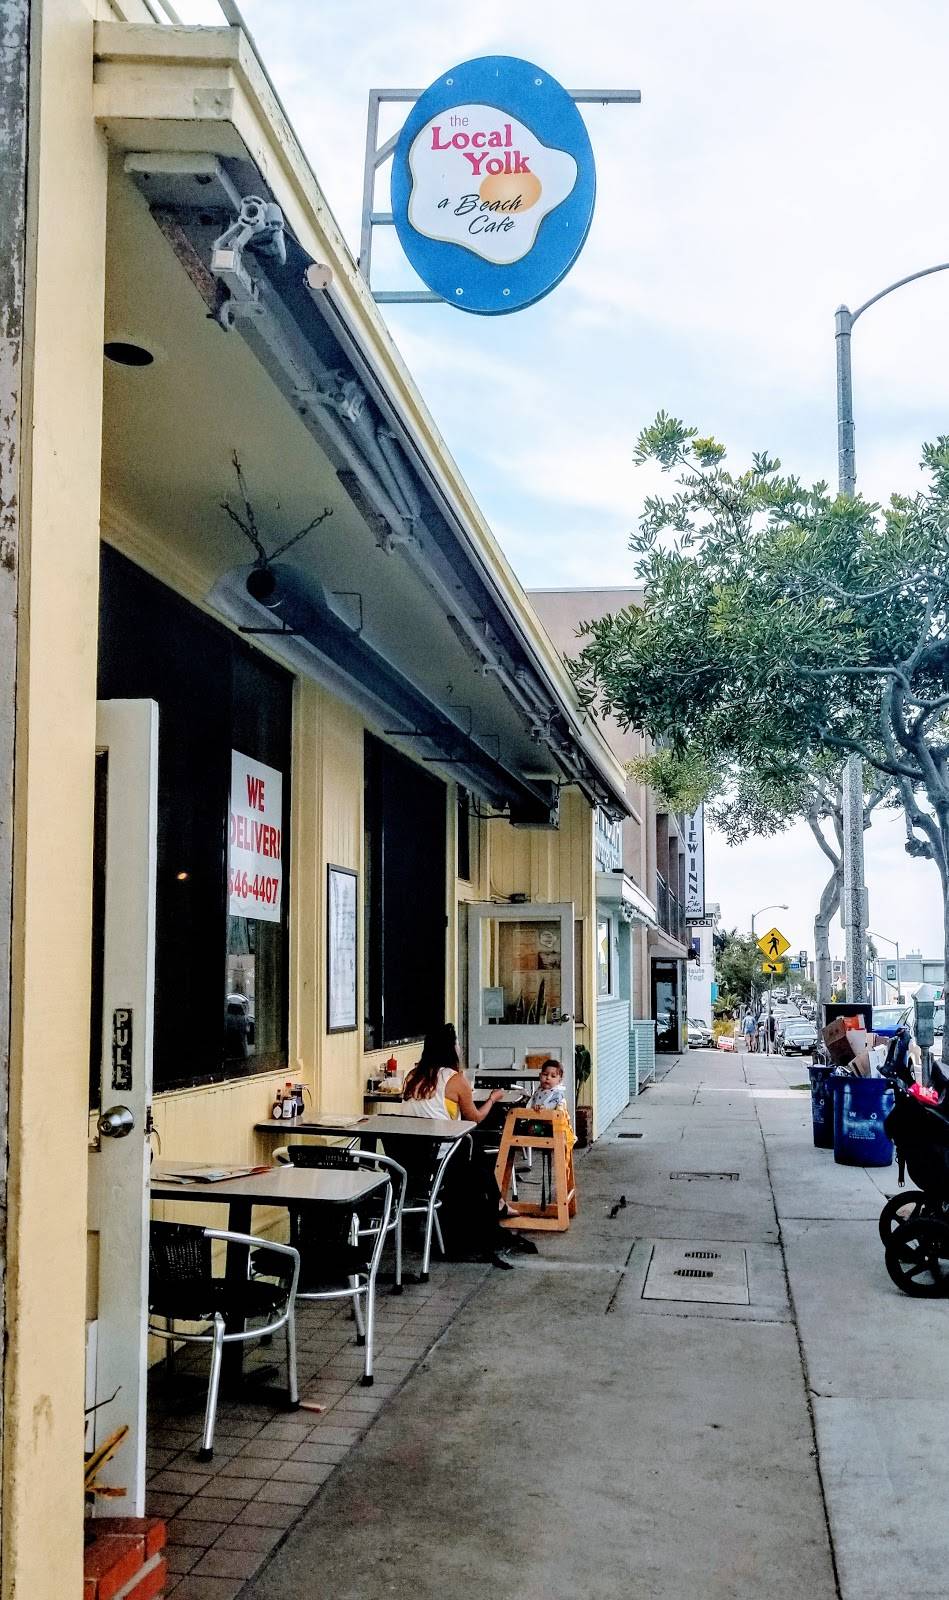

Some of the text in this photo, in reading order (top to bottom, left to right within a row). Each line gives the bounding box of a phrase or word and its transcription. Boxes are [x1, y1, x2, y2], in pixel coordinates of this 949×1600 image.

[450, 115, 469, 127] the
[431, 124, 513, 150] Local
[462, 150, 531, 176] Yolk
[437, 194, 523, 216] a Beach
[468, 215, 515, 234] Cafe
[247, 774, 265, 812] WE
[688, 858, 698, 894] INN
[116, 1010, 129, 1084] PULL
